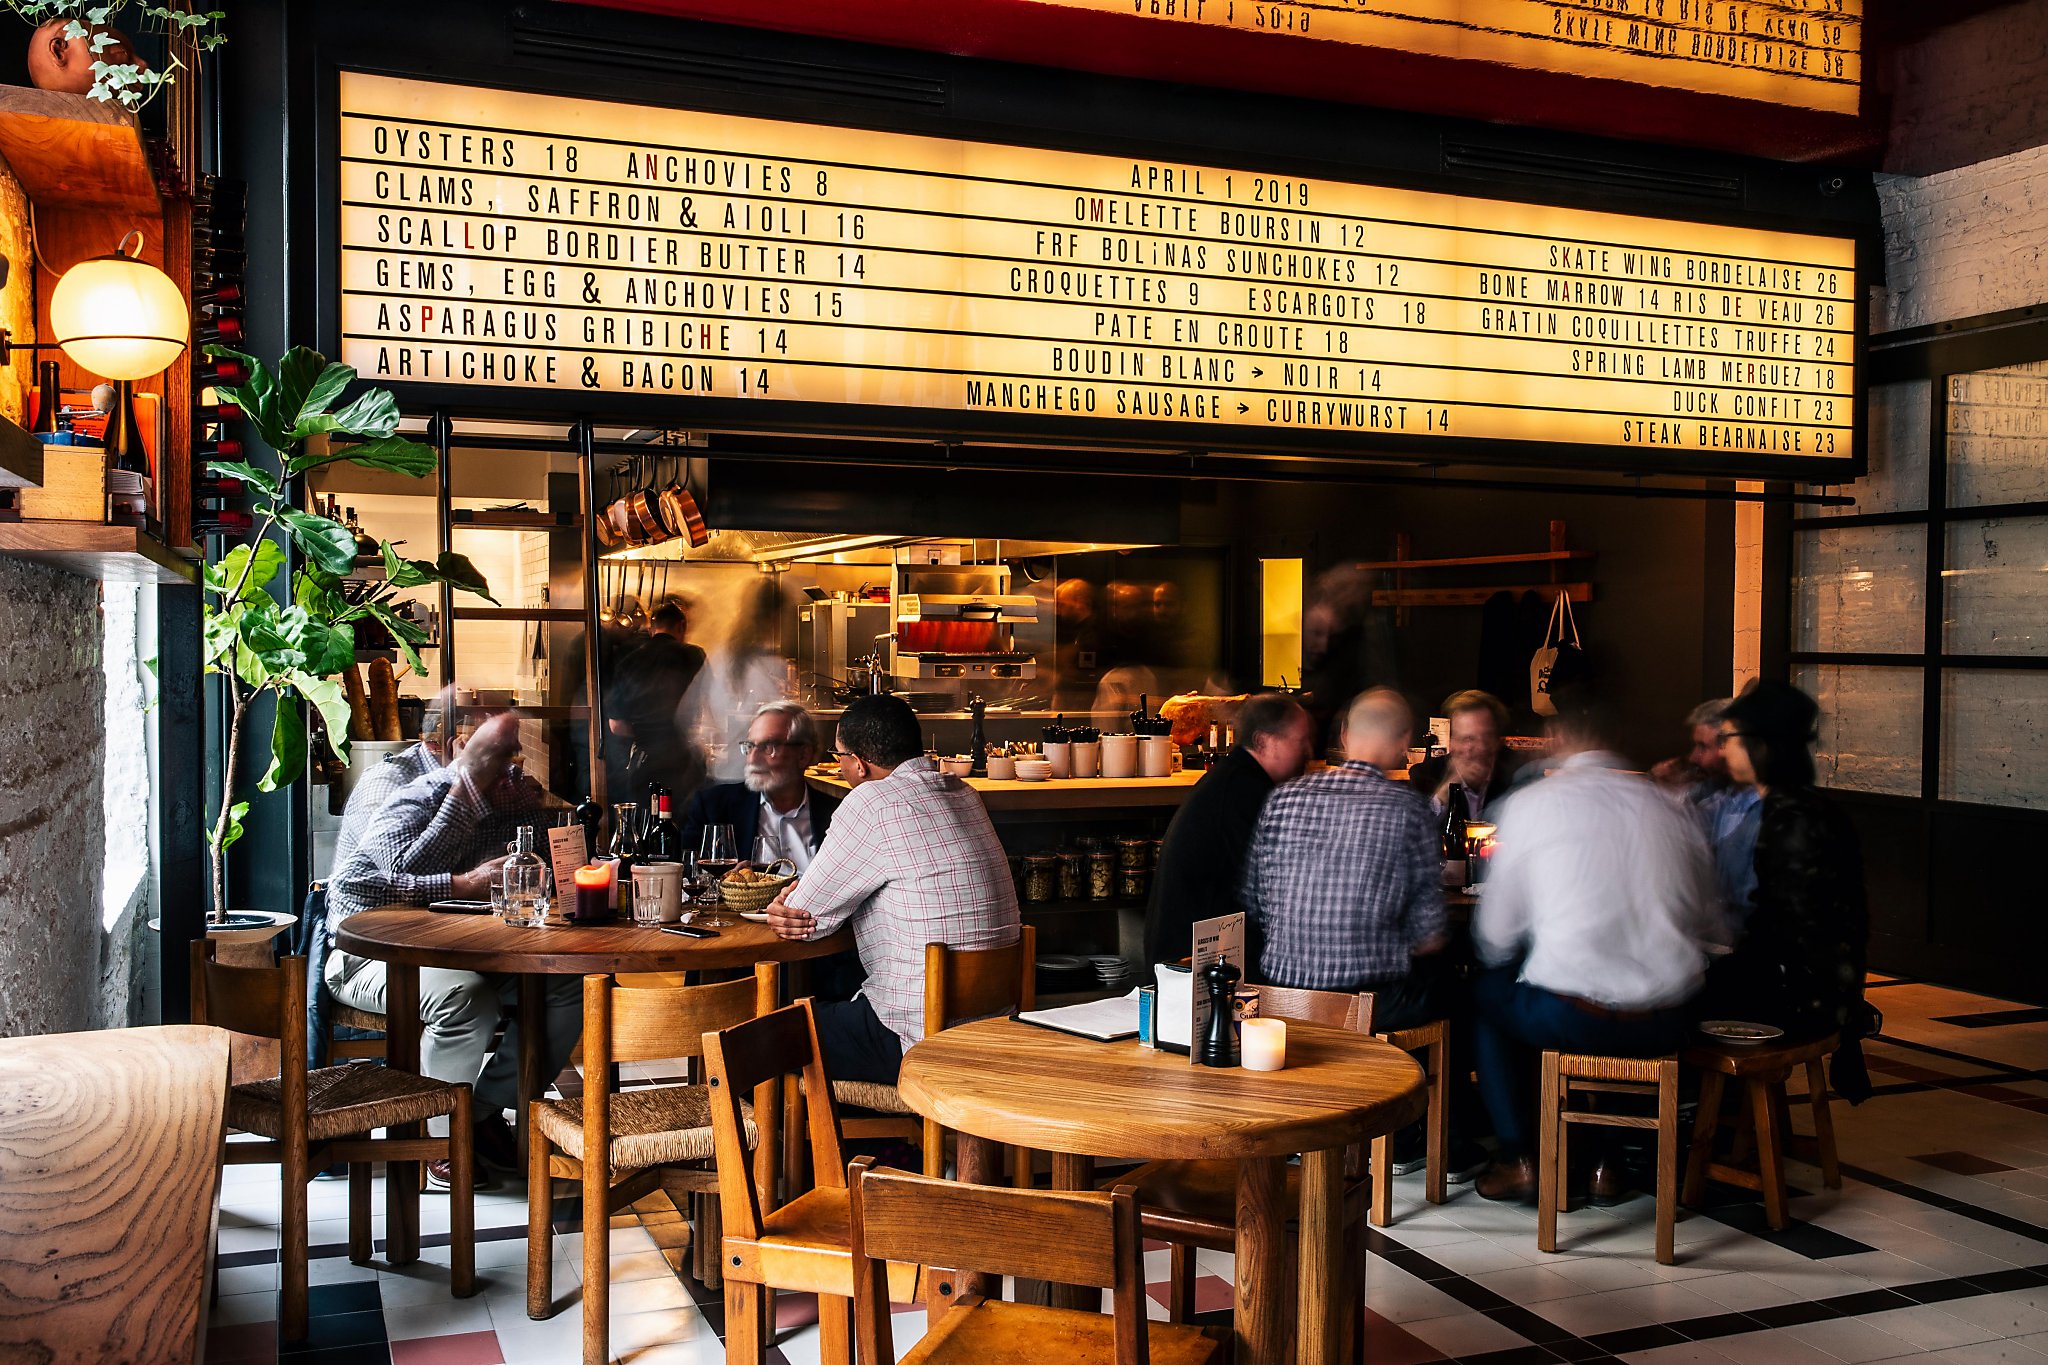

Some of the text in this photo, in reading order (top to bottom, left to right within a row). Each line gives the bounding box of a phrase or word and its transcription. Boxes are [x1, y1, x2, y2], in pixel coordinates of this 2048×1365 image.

[374, 125, 828, 197] OYSTERS 18 ANCHOVIES 8
[1130, 163, 1309, 207] APRIL 1 2019
[527, 184, 660, 223] SAFFRON
[679, 195, 699, 229] &
[723, 202, 807, 236] AIOLI
[836, 212, 865, 241] 16
[1075, 196, 1365, 249] OMELETTE BOURSIN 12
[377, 213, 866, 280] SCALLOP BORDIER BUTTER 14
[1036, 230, 1079, 259] FRF
[1226, 248, 1356, 284] SUNCHOKES
[1375, 262, 1399, 288] 12
[1549, 244, 1837, 295] SKATE WING BORDELAISE 26
[503, 267, 556, 299] EGG
[581, 271, 602, 305] &
[625, 276, 790, 315] ANCHOVIES
[813, 290, 843, 319] 15
[1010, 266, 1426, 325] CROQUETTES 9 ESCARGOTS 18
[1479, 271, 1835, 327] BONE MARROW 14 RIS DE VEAU 26
[376, 302, 788, 355] ASPARAGUS GRIBICHE 14
[1095, 311, 1348, 355] PATE EN CROUTE 18
[1481, 306, 1835, 359] GRATIN COQUILLETTES TRUFFE 24
[376, 346, 770, 395] ARTICHOKE & BACON 14
[1052, 346, 1382, 393] BOUDIN BLANC NOIR 14
[1571, 348, 1835, 391] SPRING LAMB MERGUEZ 18
[966, 379, 1450, 433] MANCHEGO SAUSAGE CURRYWURST 14
[1673, 389, 1834, 422] DUCK CONFIT 23
[1622, 419, 1835, 455] STEAK BEARNAISE 23
